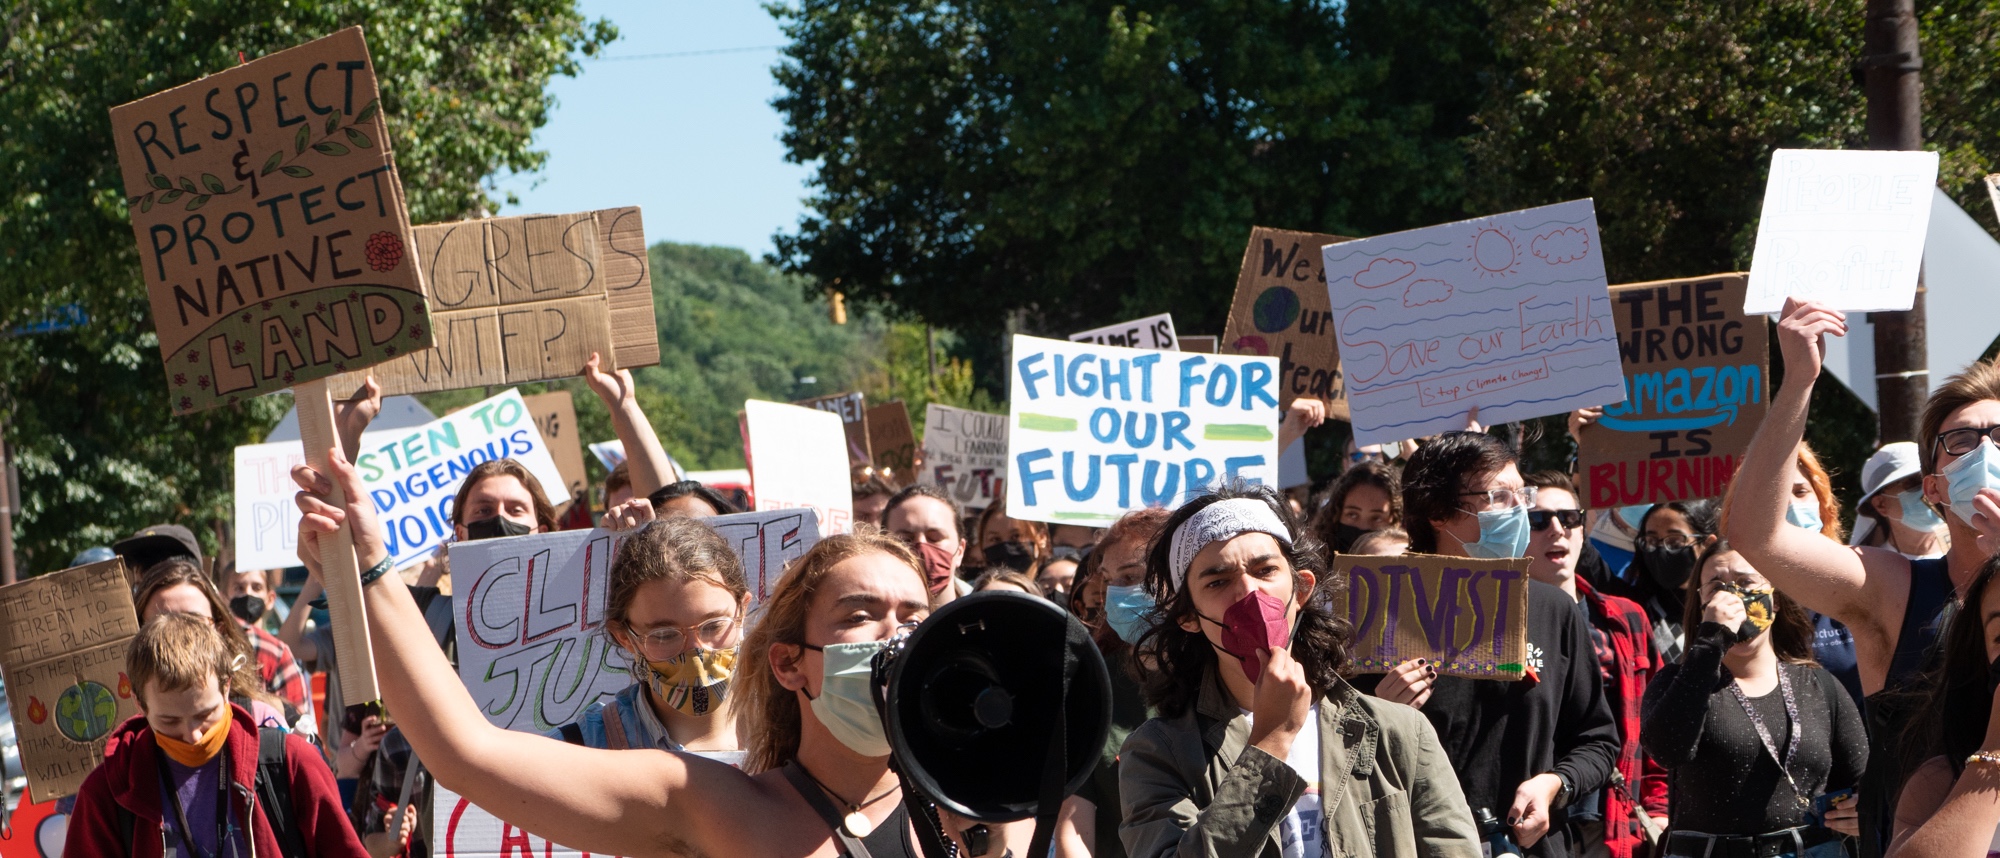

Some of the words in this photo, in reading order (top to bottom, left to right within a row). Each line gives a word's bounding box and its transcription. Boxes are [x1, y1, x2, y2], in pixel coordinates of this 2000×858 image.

[134, 61, 365, 174] RESPECT
[232, 139, 260, 199] &
[1779, 154, 1920, 214] PEOPLE
[150, 165, 391, 281] PROTECT
[173, 230, 362, 326] NATIVE
[413, 210, 644, 307] GRESS
[1261, 238, 1310, 282] We
[1619, 281, 1725, 329] THE
[208, 293, 405, 397] LAND
[410, 308, 567, 382] WTF?
[1150, 320, 1173, 349] IS
[1340, 305, 1440, 384] Save
[1458, 329, 1506, 361] our
[1519, 295, 1603, 351] Earth
[1617, 320, 1743, 364] WRONG
[1018, 352, 1161, 403] FIGHT
[1179, 355, 1278, 410] FOR
[1279, 342, 1346, 400] teac
[1423, 385, 1460, 402] Stop
[1466, 374, 1507, 392] Climate
[1512, 367, 1543, 381] Change
[815, 392, 864, 424] ANET
[1089, 407, 1196, 450] OUR
[357, 421, 462, 483] STEN
[469, 397, 523, 435] TO
[1650, 428, 1712, 459] IS
[371, 430, 534, 515] DIGENOUS
[1017, 447, 1267, 508] FUTURE
[1589, 453, 1745, 508] BURNIN
[3, 590, 36, 617] THE
[39, 570, 120, 606] GREATEST
[11, 607, 76, 641] THREAT
[82, 601, 107, 618] TO
[1346, 564, 1521, 658] DIVEST
[13, 638, 52, 663] THE
[60, 617, 125, 650] PLANET
[14, 668, 35, 688] IS
[36, 660, 69, 680] THE
[73, 643, 128, 673] BELIEF
[25, 735, 56, 754] THAT
[35, 761, 78, 781] WILL
